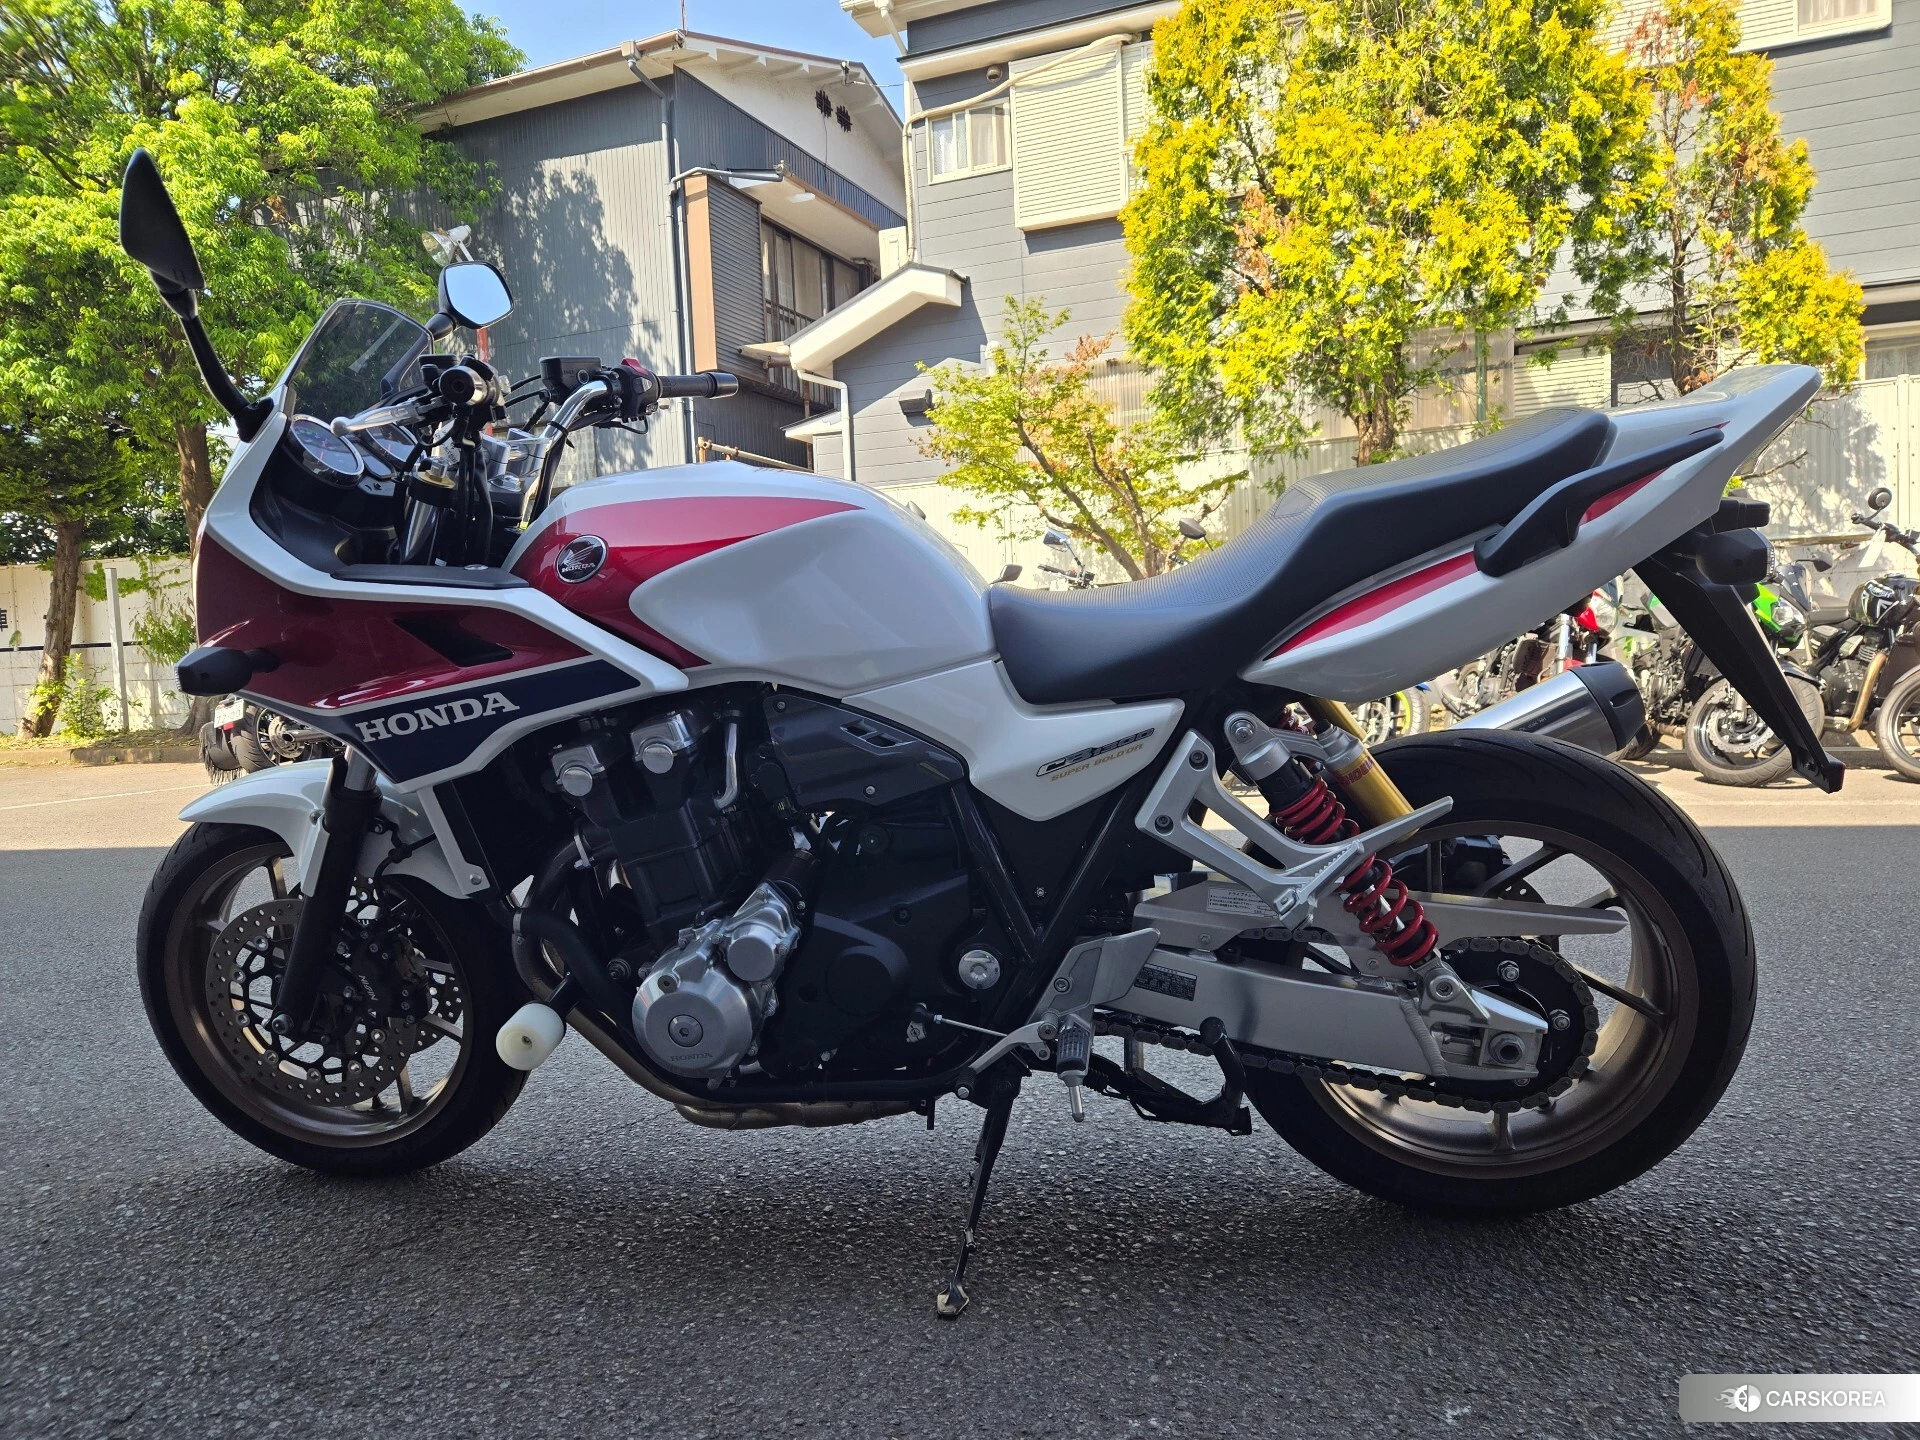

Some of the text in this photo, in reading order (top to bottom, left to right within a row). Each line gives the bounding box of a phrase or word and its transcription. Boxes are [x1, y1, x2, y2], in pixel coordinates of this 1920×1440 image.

[355, 691, 521, 743] HONDA
[1036, 727, 1155, 777] CB1300
[1051, 763, 1090, 781] SUPER
[670, 1052, 713, 1062] HONDA
